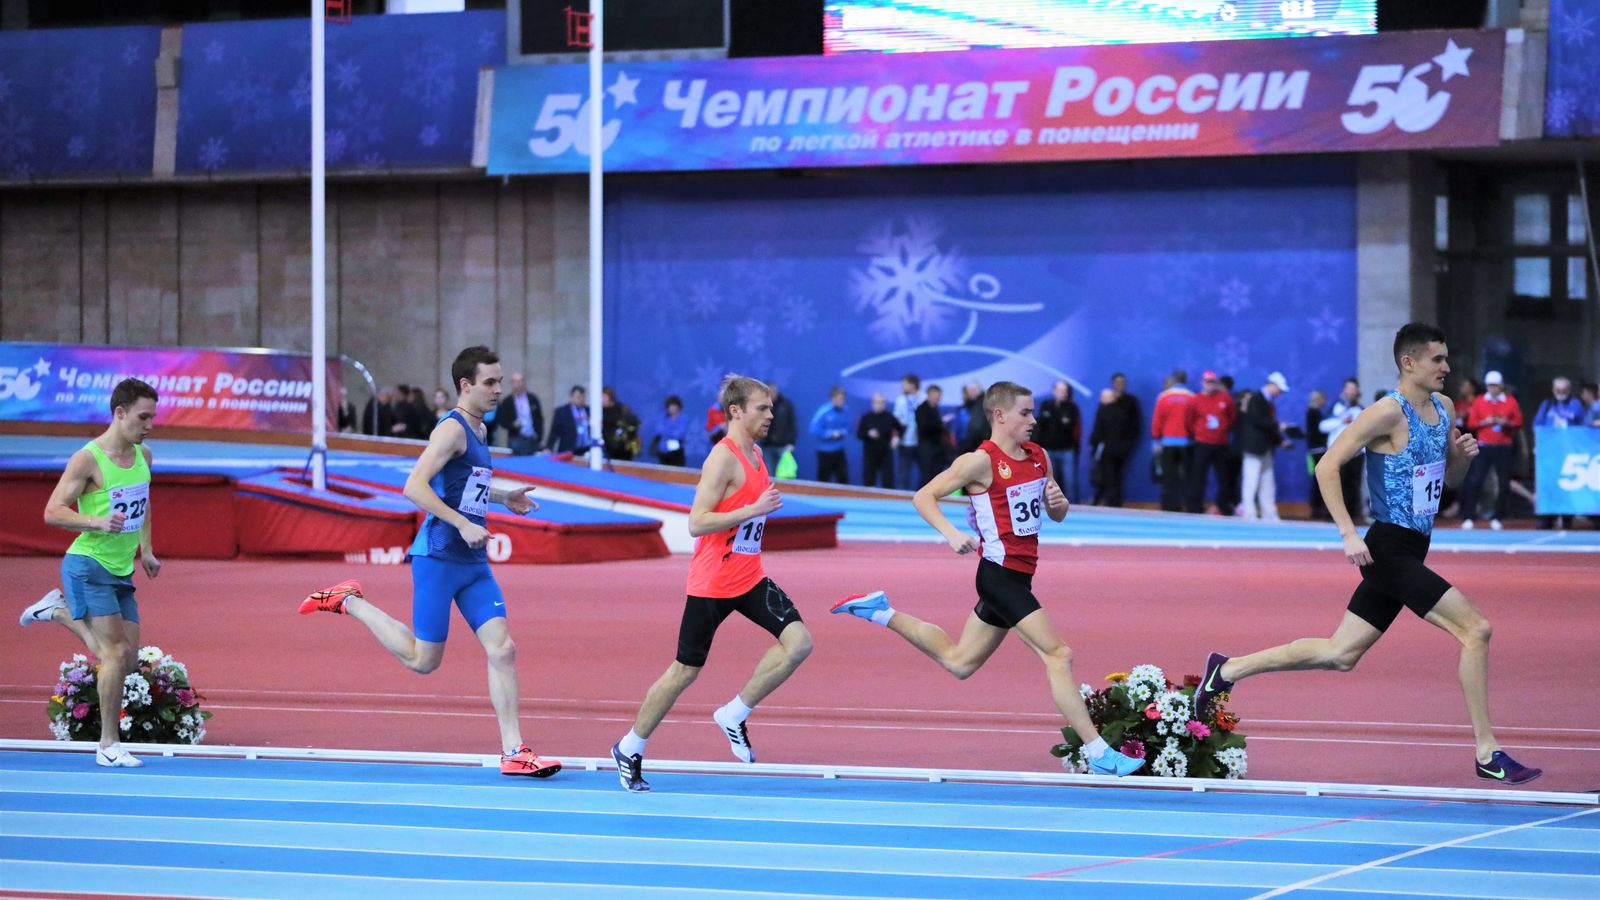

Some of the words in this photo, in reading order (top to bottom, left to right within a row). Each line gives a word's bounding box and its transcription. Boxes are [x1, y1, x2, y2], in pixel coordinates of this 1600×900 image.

[662, 79, 1030, 128] Чемпионат
[1044, 65, 1311, 118] России
[751, 135, 782, 152] по
[787, 130, 878, 151] легкой
[884, 127, 1009, 149] атлетике
[1015, 128, 1032, 145] в
[1038, 122, 1200, 145] помещении
[213, 372, 313, 398] России
[220, 398, 308, 414] помещении
[1424, 478, 1441, 502] 15
[742, 521, 763, 542] 18
